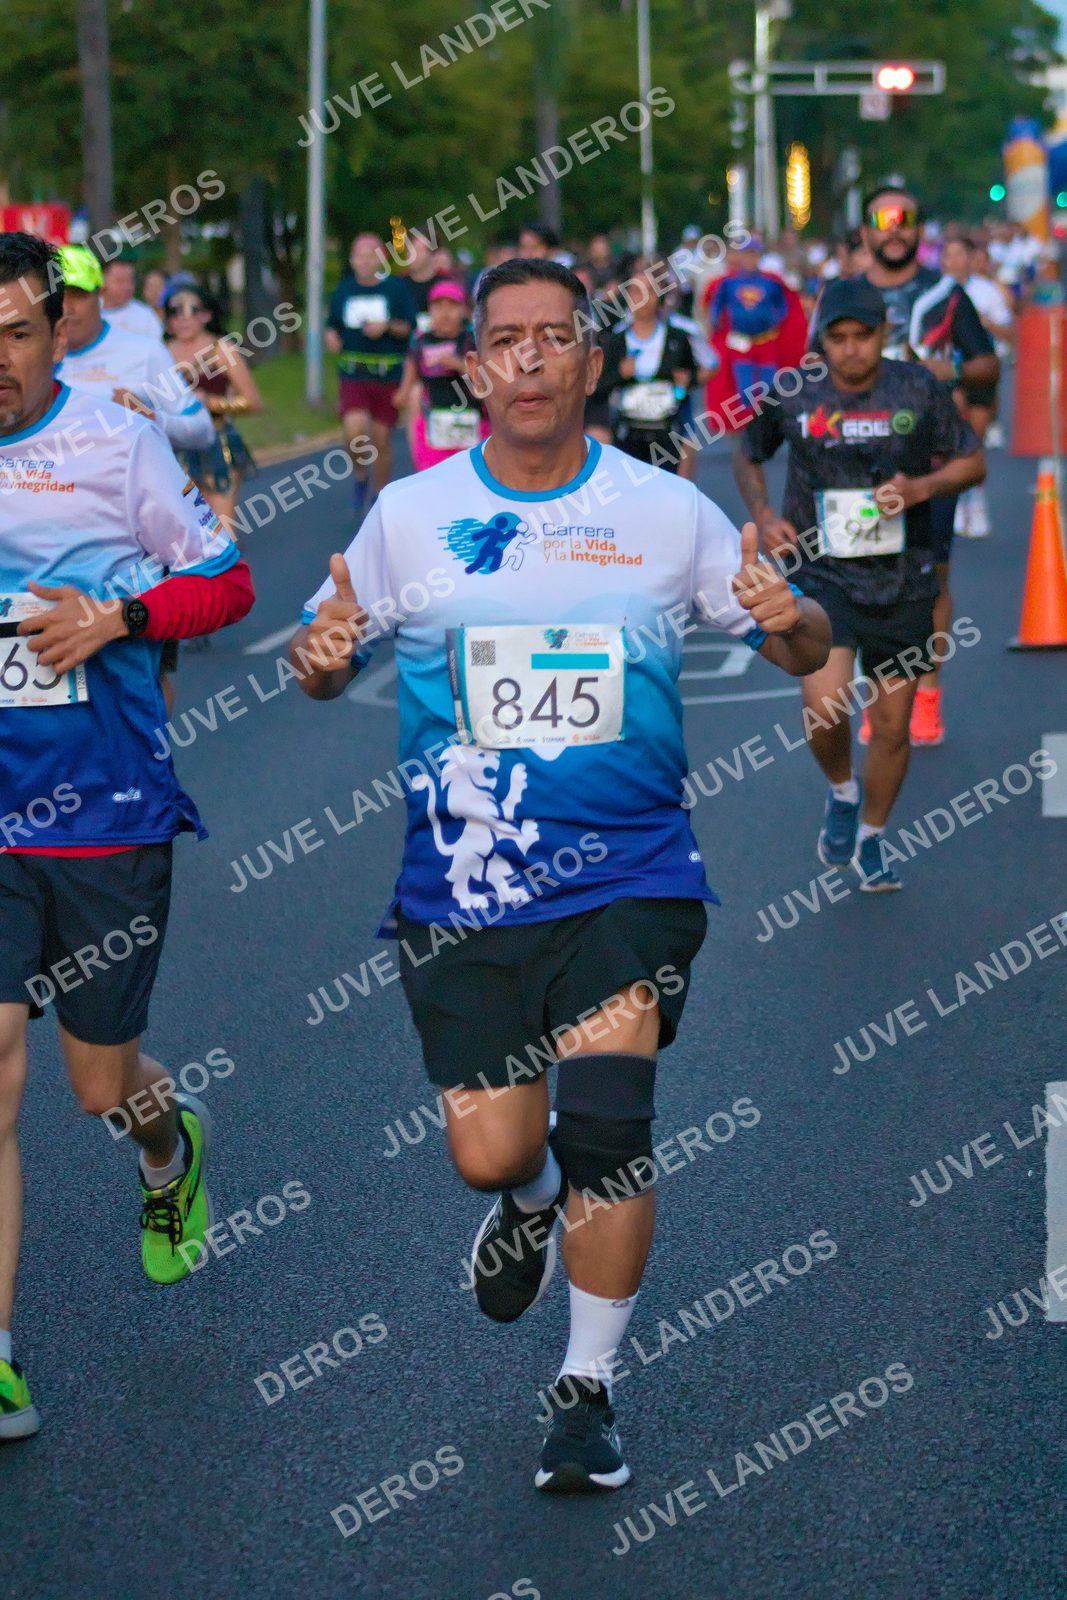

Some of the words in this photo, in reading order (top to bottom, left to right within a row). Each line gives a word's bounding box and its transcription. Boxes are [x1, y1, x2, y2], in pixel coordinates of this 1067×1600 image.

[26, 469, 52, 480] Vida
[11, 481, 75, 493] Integridad
[542, 523, 615, 538] Carrera
[845, 520, 881, 546] 94
[544, 540, 565, 551] por
[570, 539, 581, 549] la
[585, 539, 617, 551] Vida
[544, 552, 551, 563] y
[555, 551, 567, 561] la
[571, 551, 643, 566] Integridad
[492, 677, 600, 730] 845
